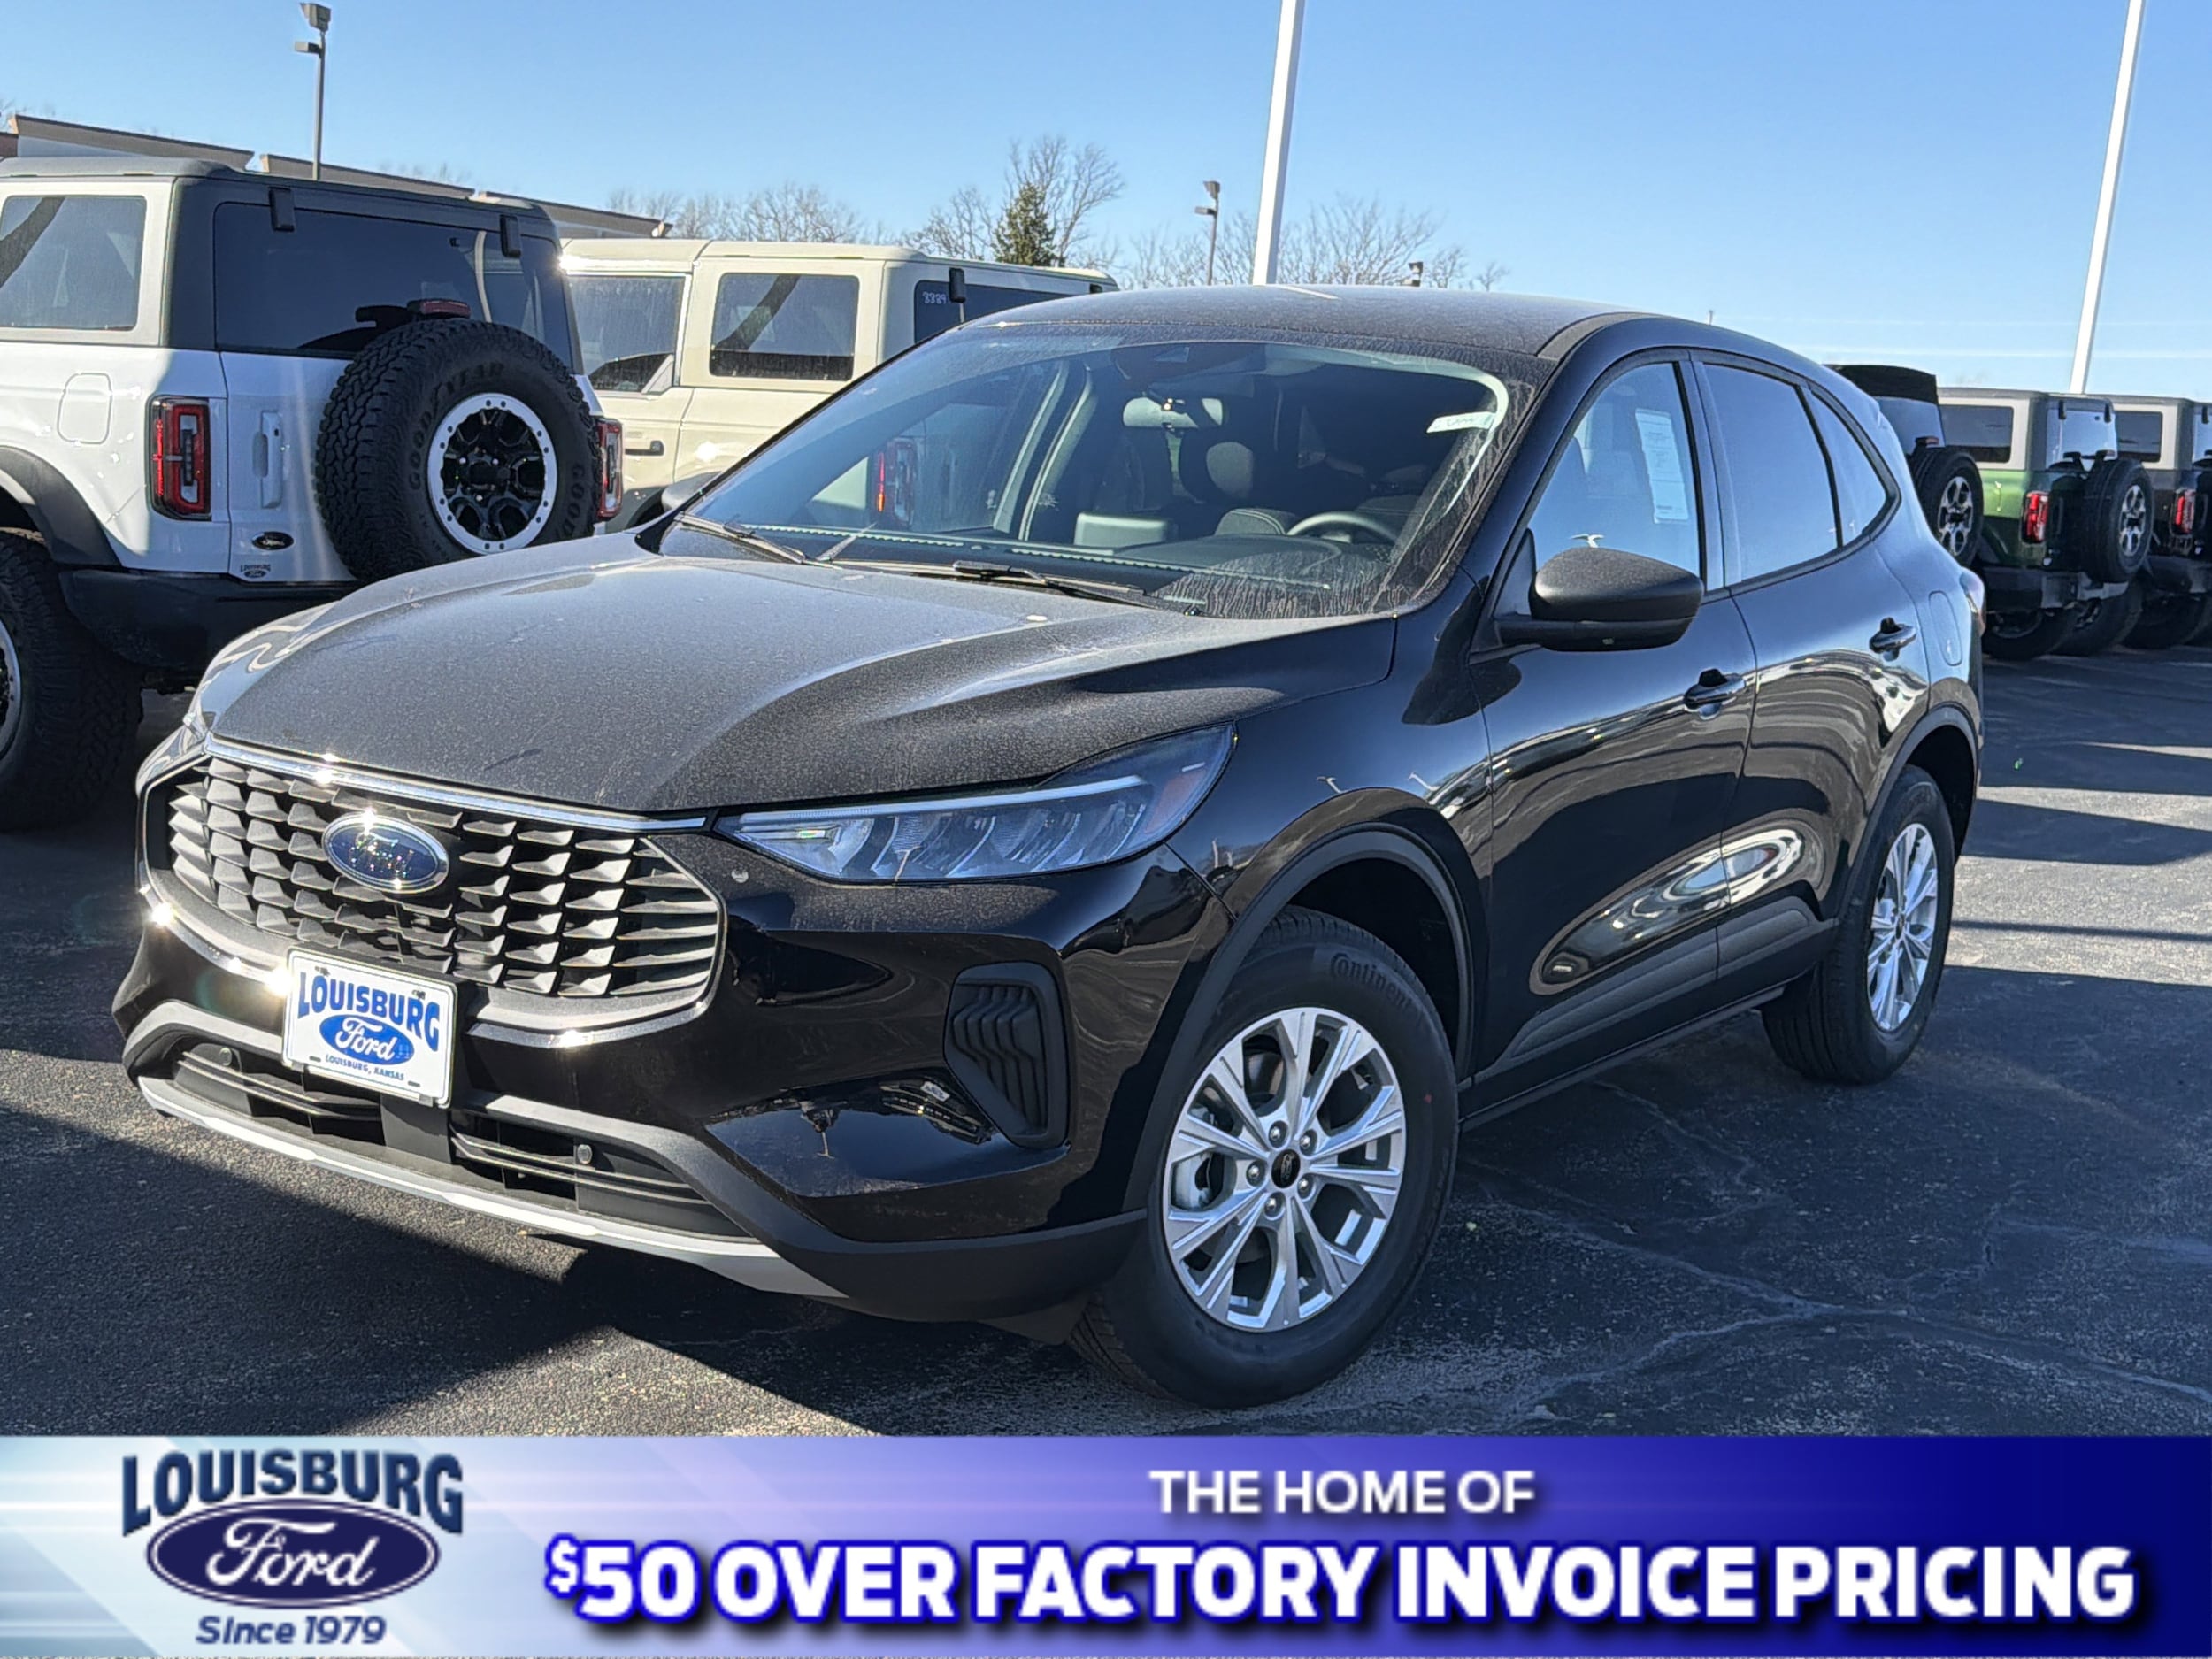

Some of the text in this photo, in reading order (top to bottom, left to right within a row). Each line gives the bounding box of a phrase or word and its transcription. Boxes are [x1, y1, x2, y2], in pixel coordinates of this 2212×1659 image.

[296, 971, 441, 1053] LOUISBURG
[334, 1018, 398, 1061] Ford
[373, 1066, 405, 1081] KANSAS
